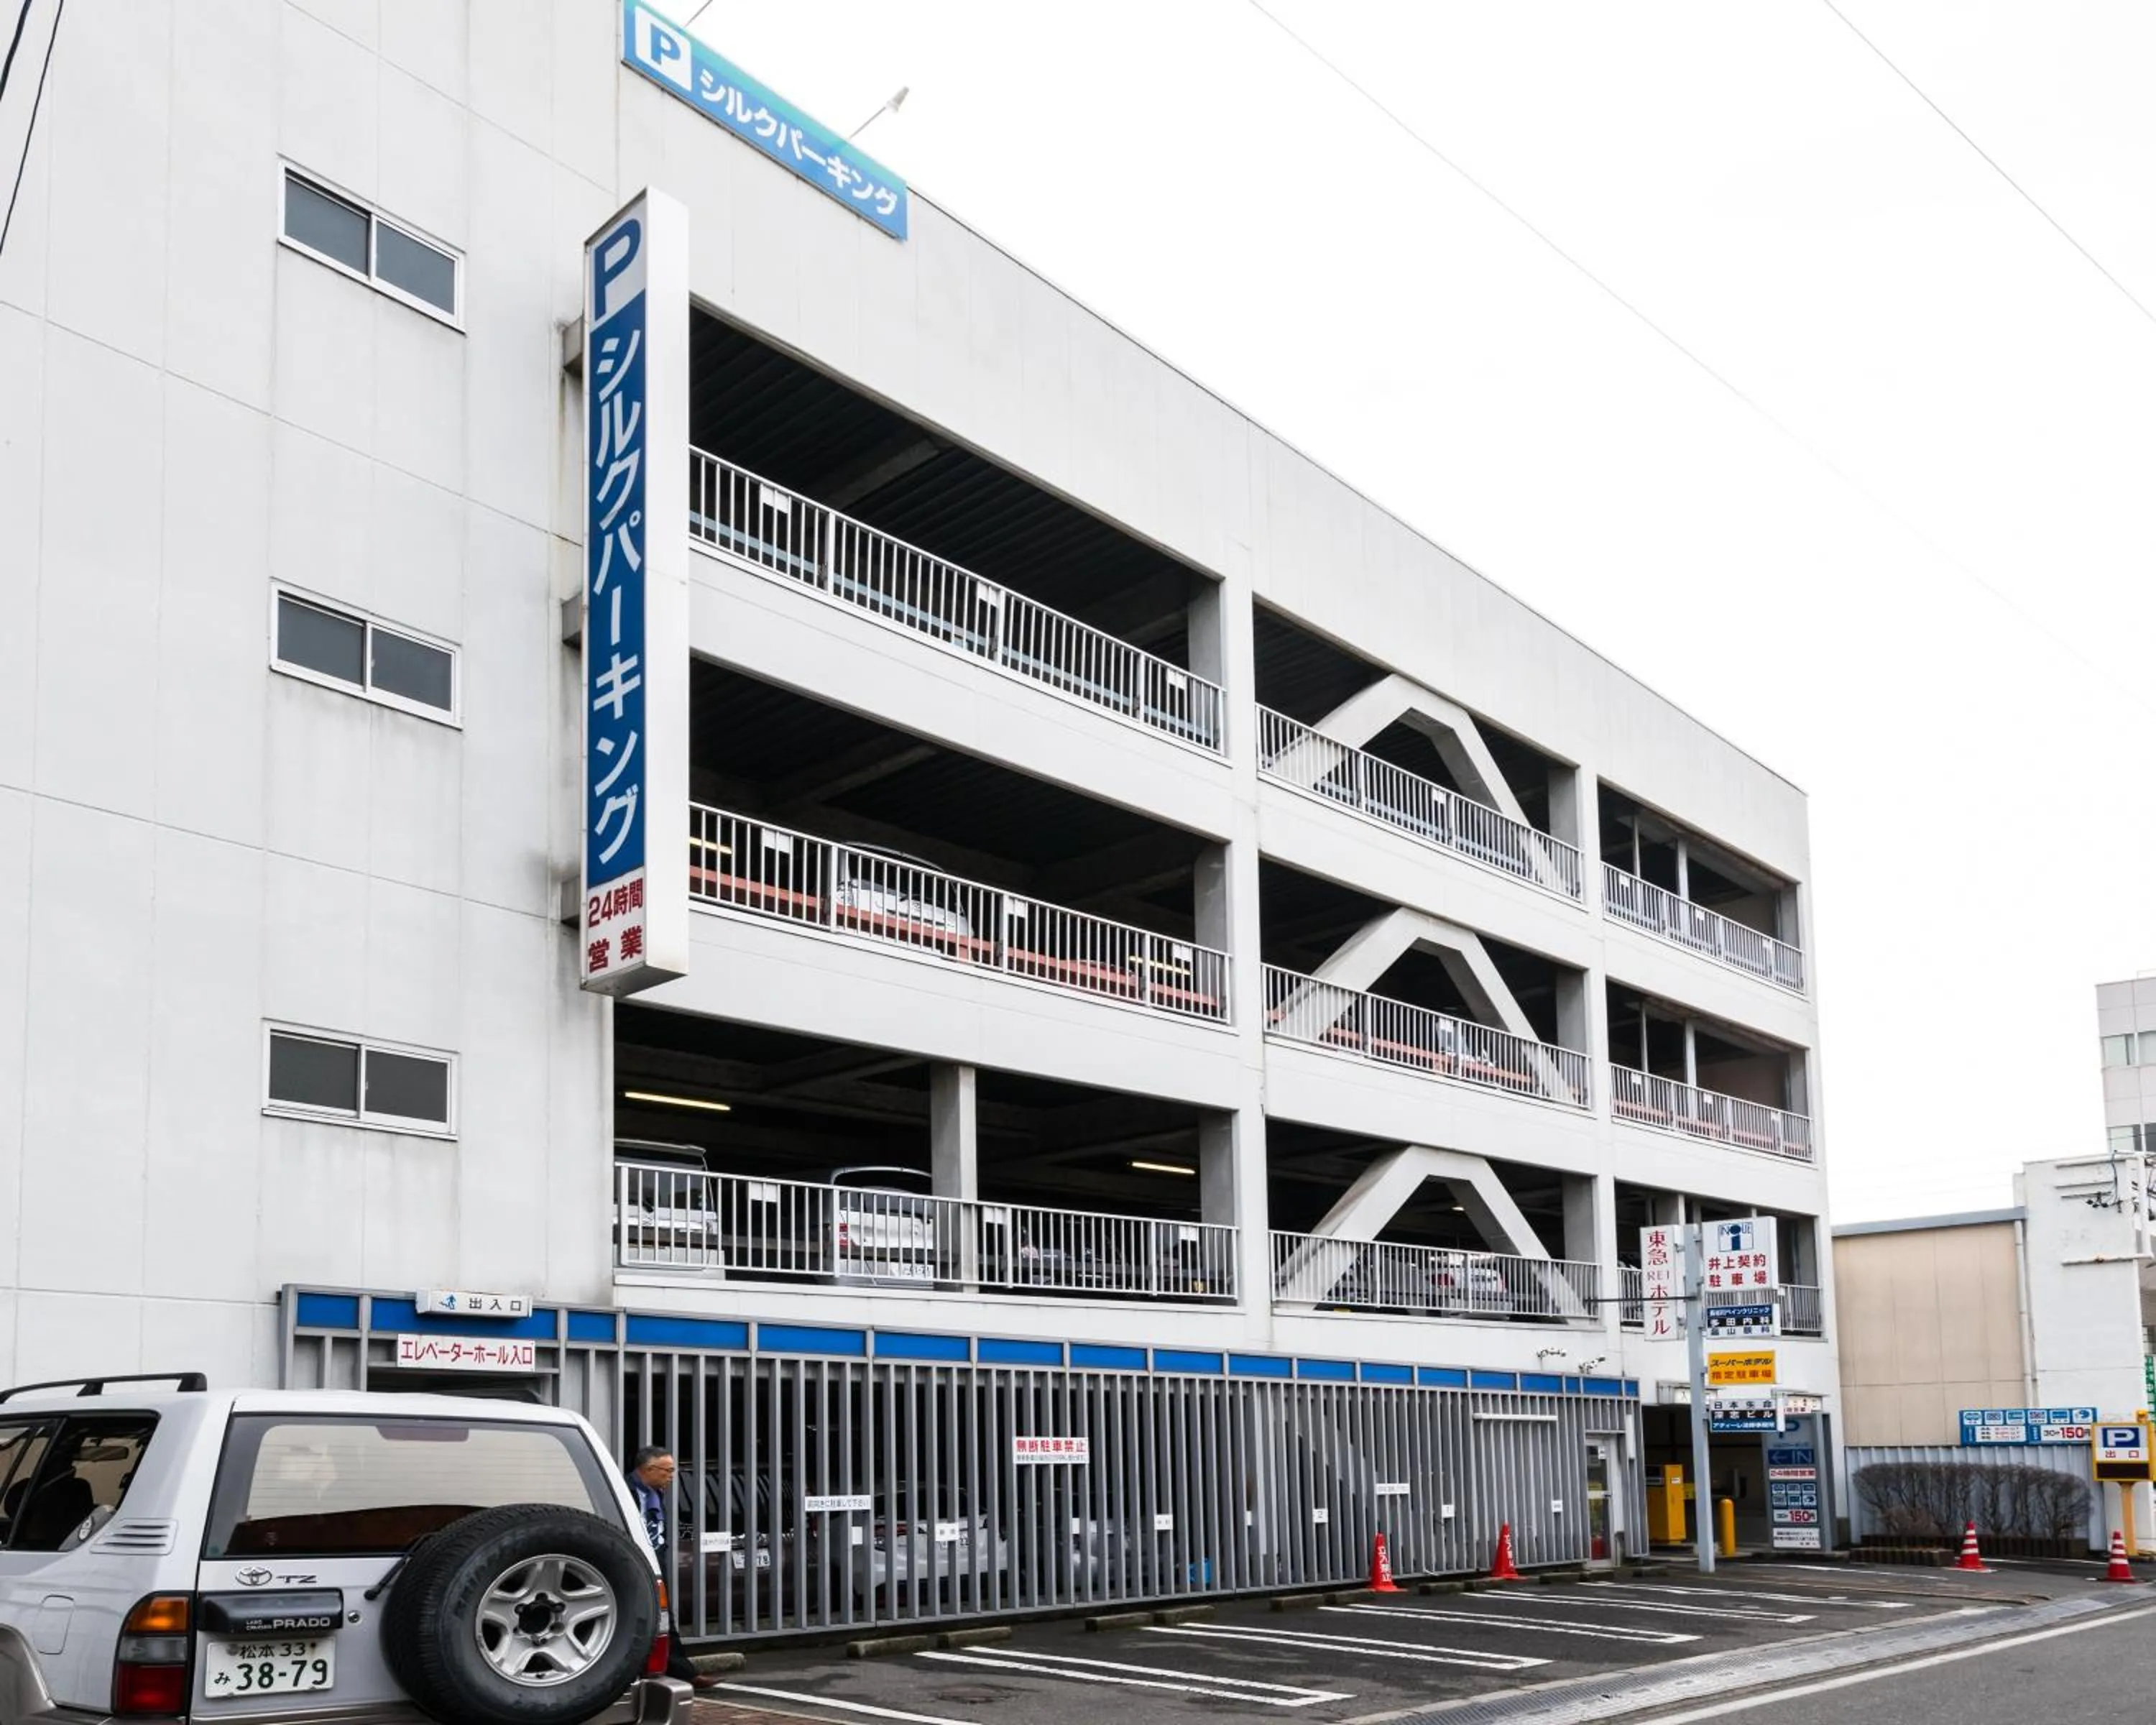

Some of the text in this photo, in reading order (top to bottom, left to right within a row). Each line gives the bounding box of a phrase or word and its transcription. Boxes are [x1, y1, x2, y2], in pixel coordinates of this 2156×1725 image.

[650, 23, 898, 216] P シルクパーキング
[594, 218, 642, 323] P
[594, 329, 642, 864] シルクパーキング
[589, 878, 643, 928] 24時間
[589, 926, 643, 972] 営業
[1708, 1254, 1766, 1271] 井上契約
[1709, 1271, 1766, 1287] 駐車場
[469, 1298, 522, 1312] 出入口
[400, 1341, 533, 1365] エレベーターホール入口
[1016, 1440, 1087, 1453] 無断駐車禁止
[2107, 1429, 2135, 1447] P
[1792, 1450, 1812, 1463] IN
[2105, 1450, 2139, 1458] 出口
[274, 1617, 331, 1629] PRADO
[239, 1642, 306, 1659] 松本 33
[214, 1658, 328, 1690] み 38-79
